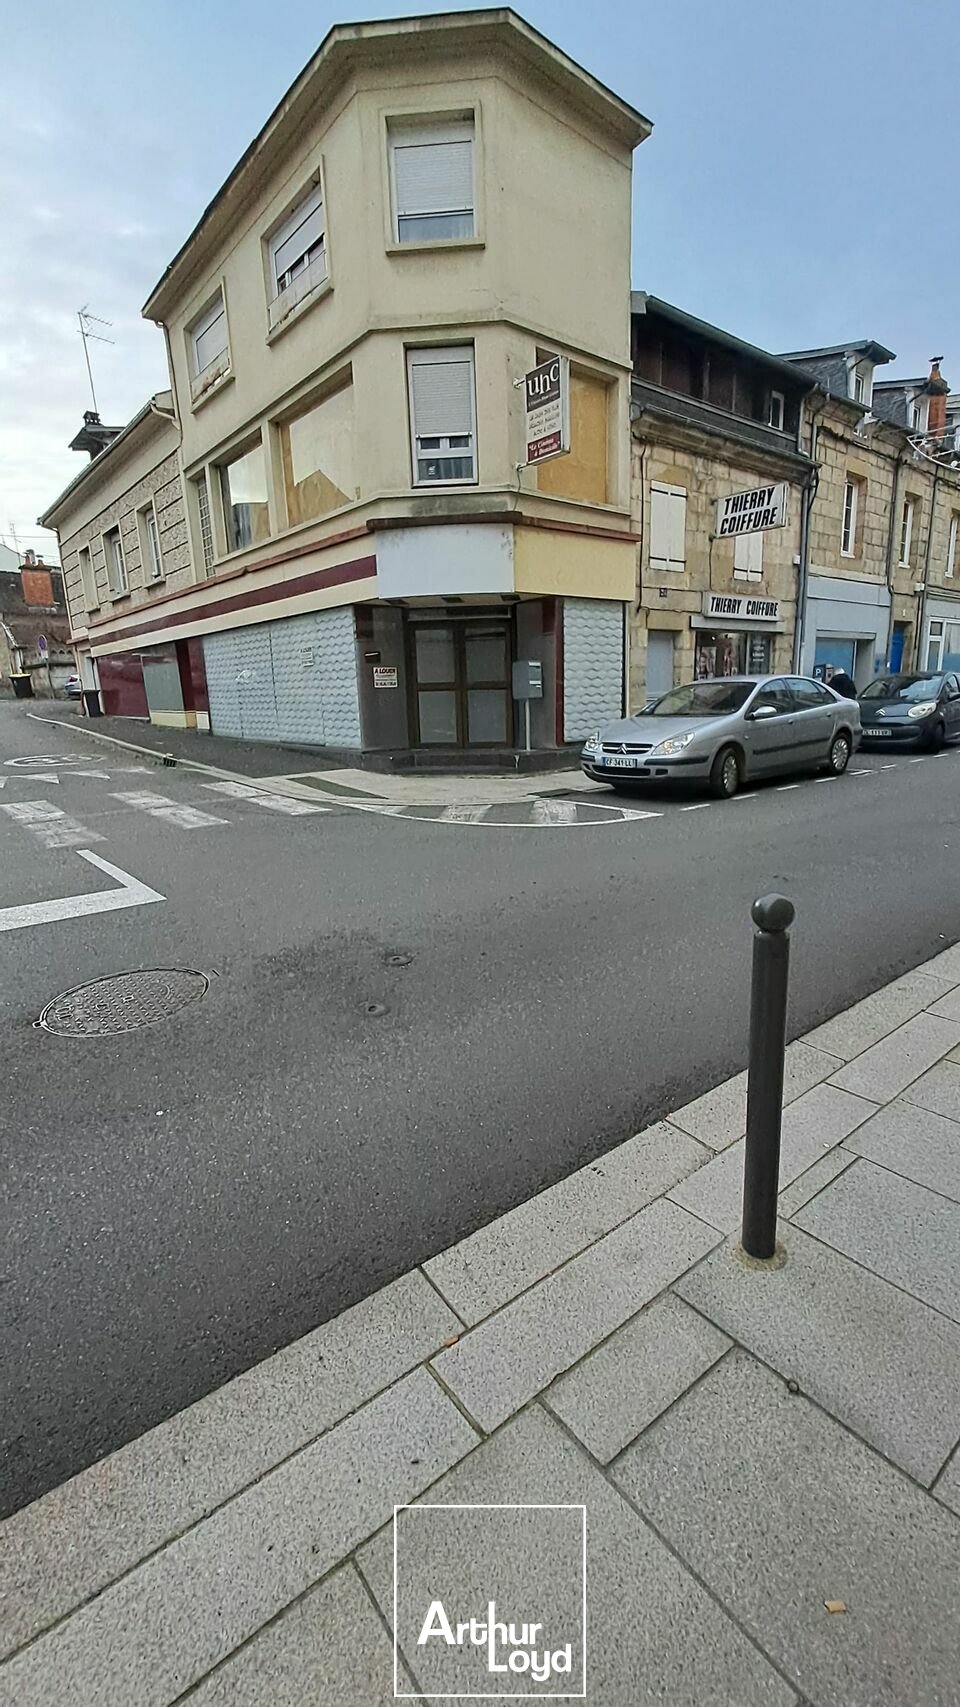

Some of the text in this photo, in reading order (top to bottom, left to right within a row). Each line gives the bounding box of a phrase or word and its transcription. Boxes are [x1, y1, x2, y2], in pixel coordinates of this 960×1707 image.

[724, 487, 775, 515] THIERRY
[720, 507, 778, 535] COIFFURE
[710, 597, 778, 616] THIERRY COIFFURE
